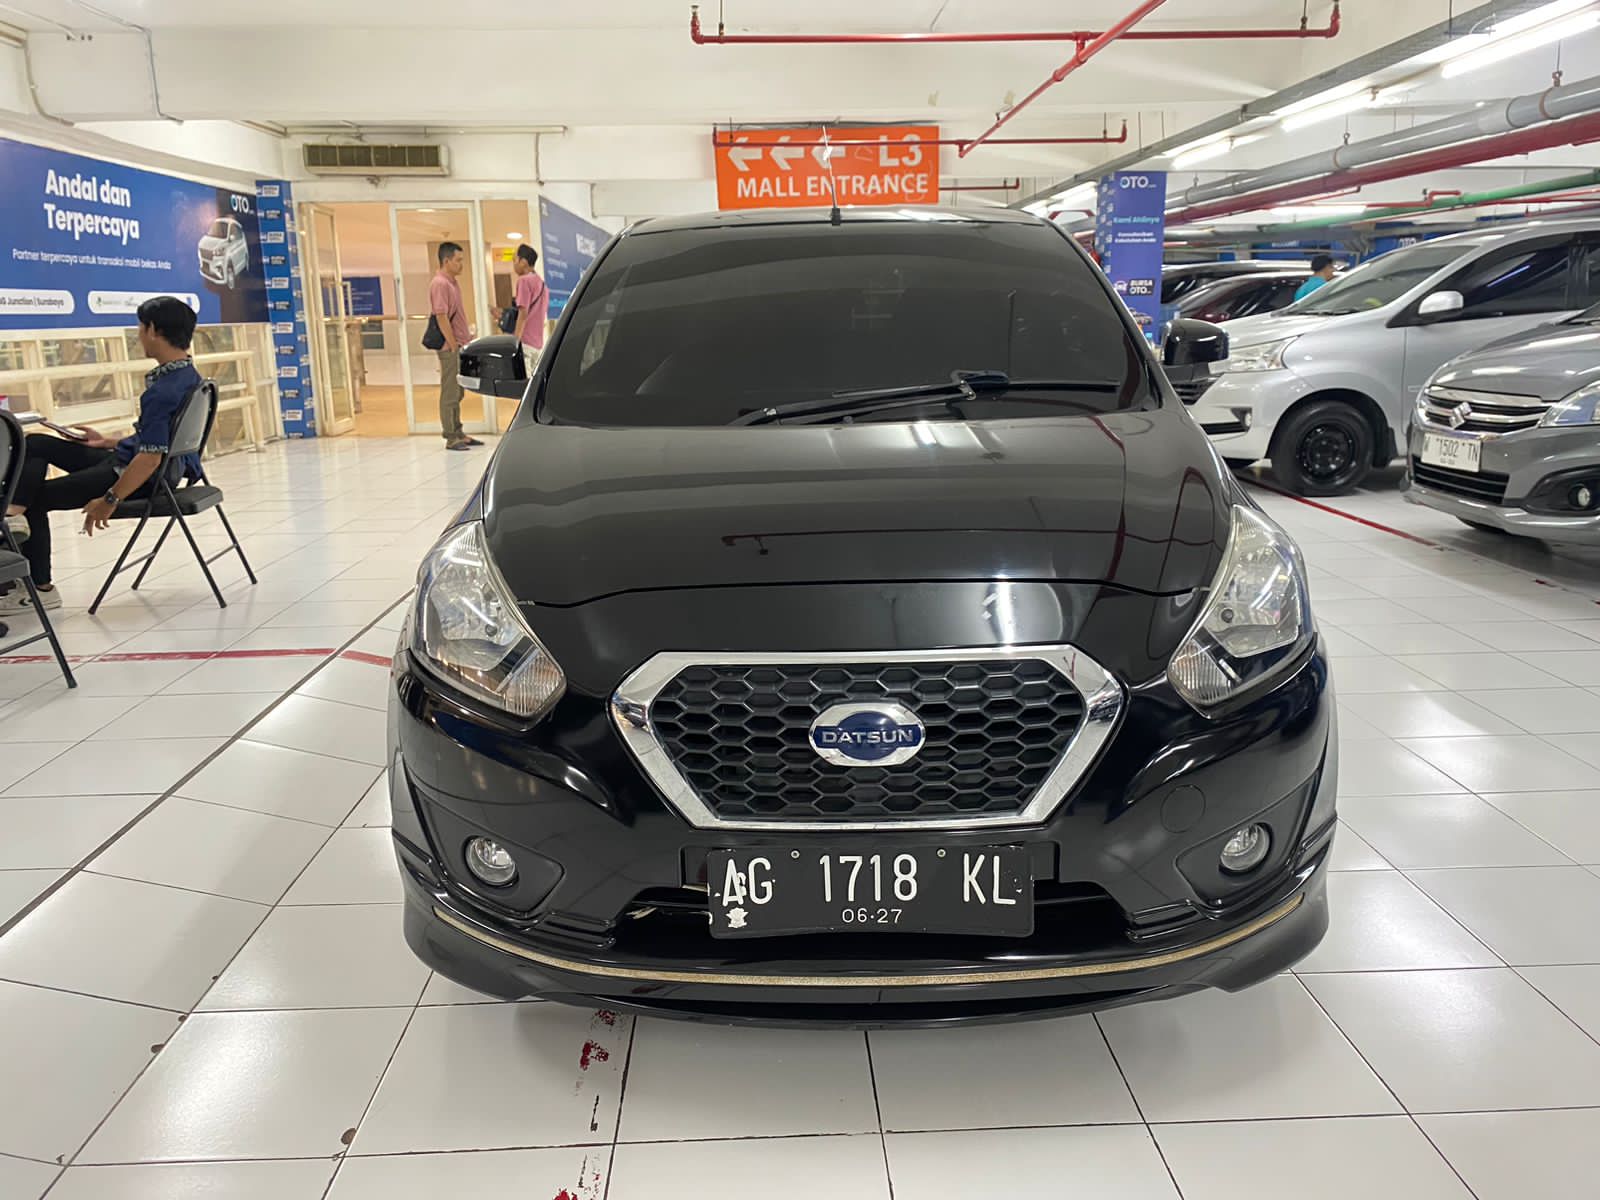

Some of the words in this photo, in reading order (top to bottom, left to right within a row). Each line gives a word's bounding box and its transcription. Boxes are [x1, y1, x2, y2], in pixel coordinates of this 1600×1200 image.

[879, 134, 922, 168] L3
[45, 169, 98, 202] Andal
[100, 179, 131, 208] dan
[737, 175, 800, 198] MALL
[806, 173, 929, 197] ENTRANCE
[1120, 176, 1149, 189] OTO
[231, 194, 249, 213] OTO
[43, 202, 140, 246] Terpercaya
[12, 248, 40, 261] Partner
[40, 251, 78, 266] terpercaya
[79, 254, 97, 265] untuk
[1129, 286, 1148, 295] OTO
[1440, 439, 1459, 458] 1502
[821, 729, 913, 744] DATSUN
[722, 857, 773, 908] AG
[819, 853, 918, 902] 1718
[963, 852, 1017, 905] KL
